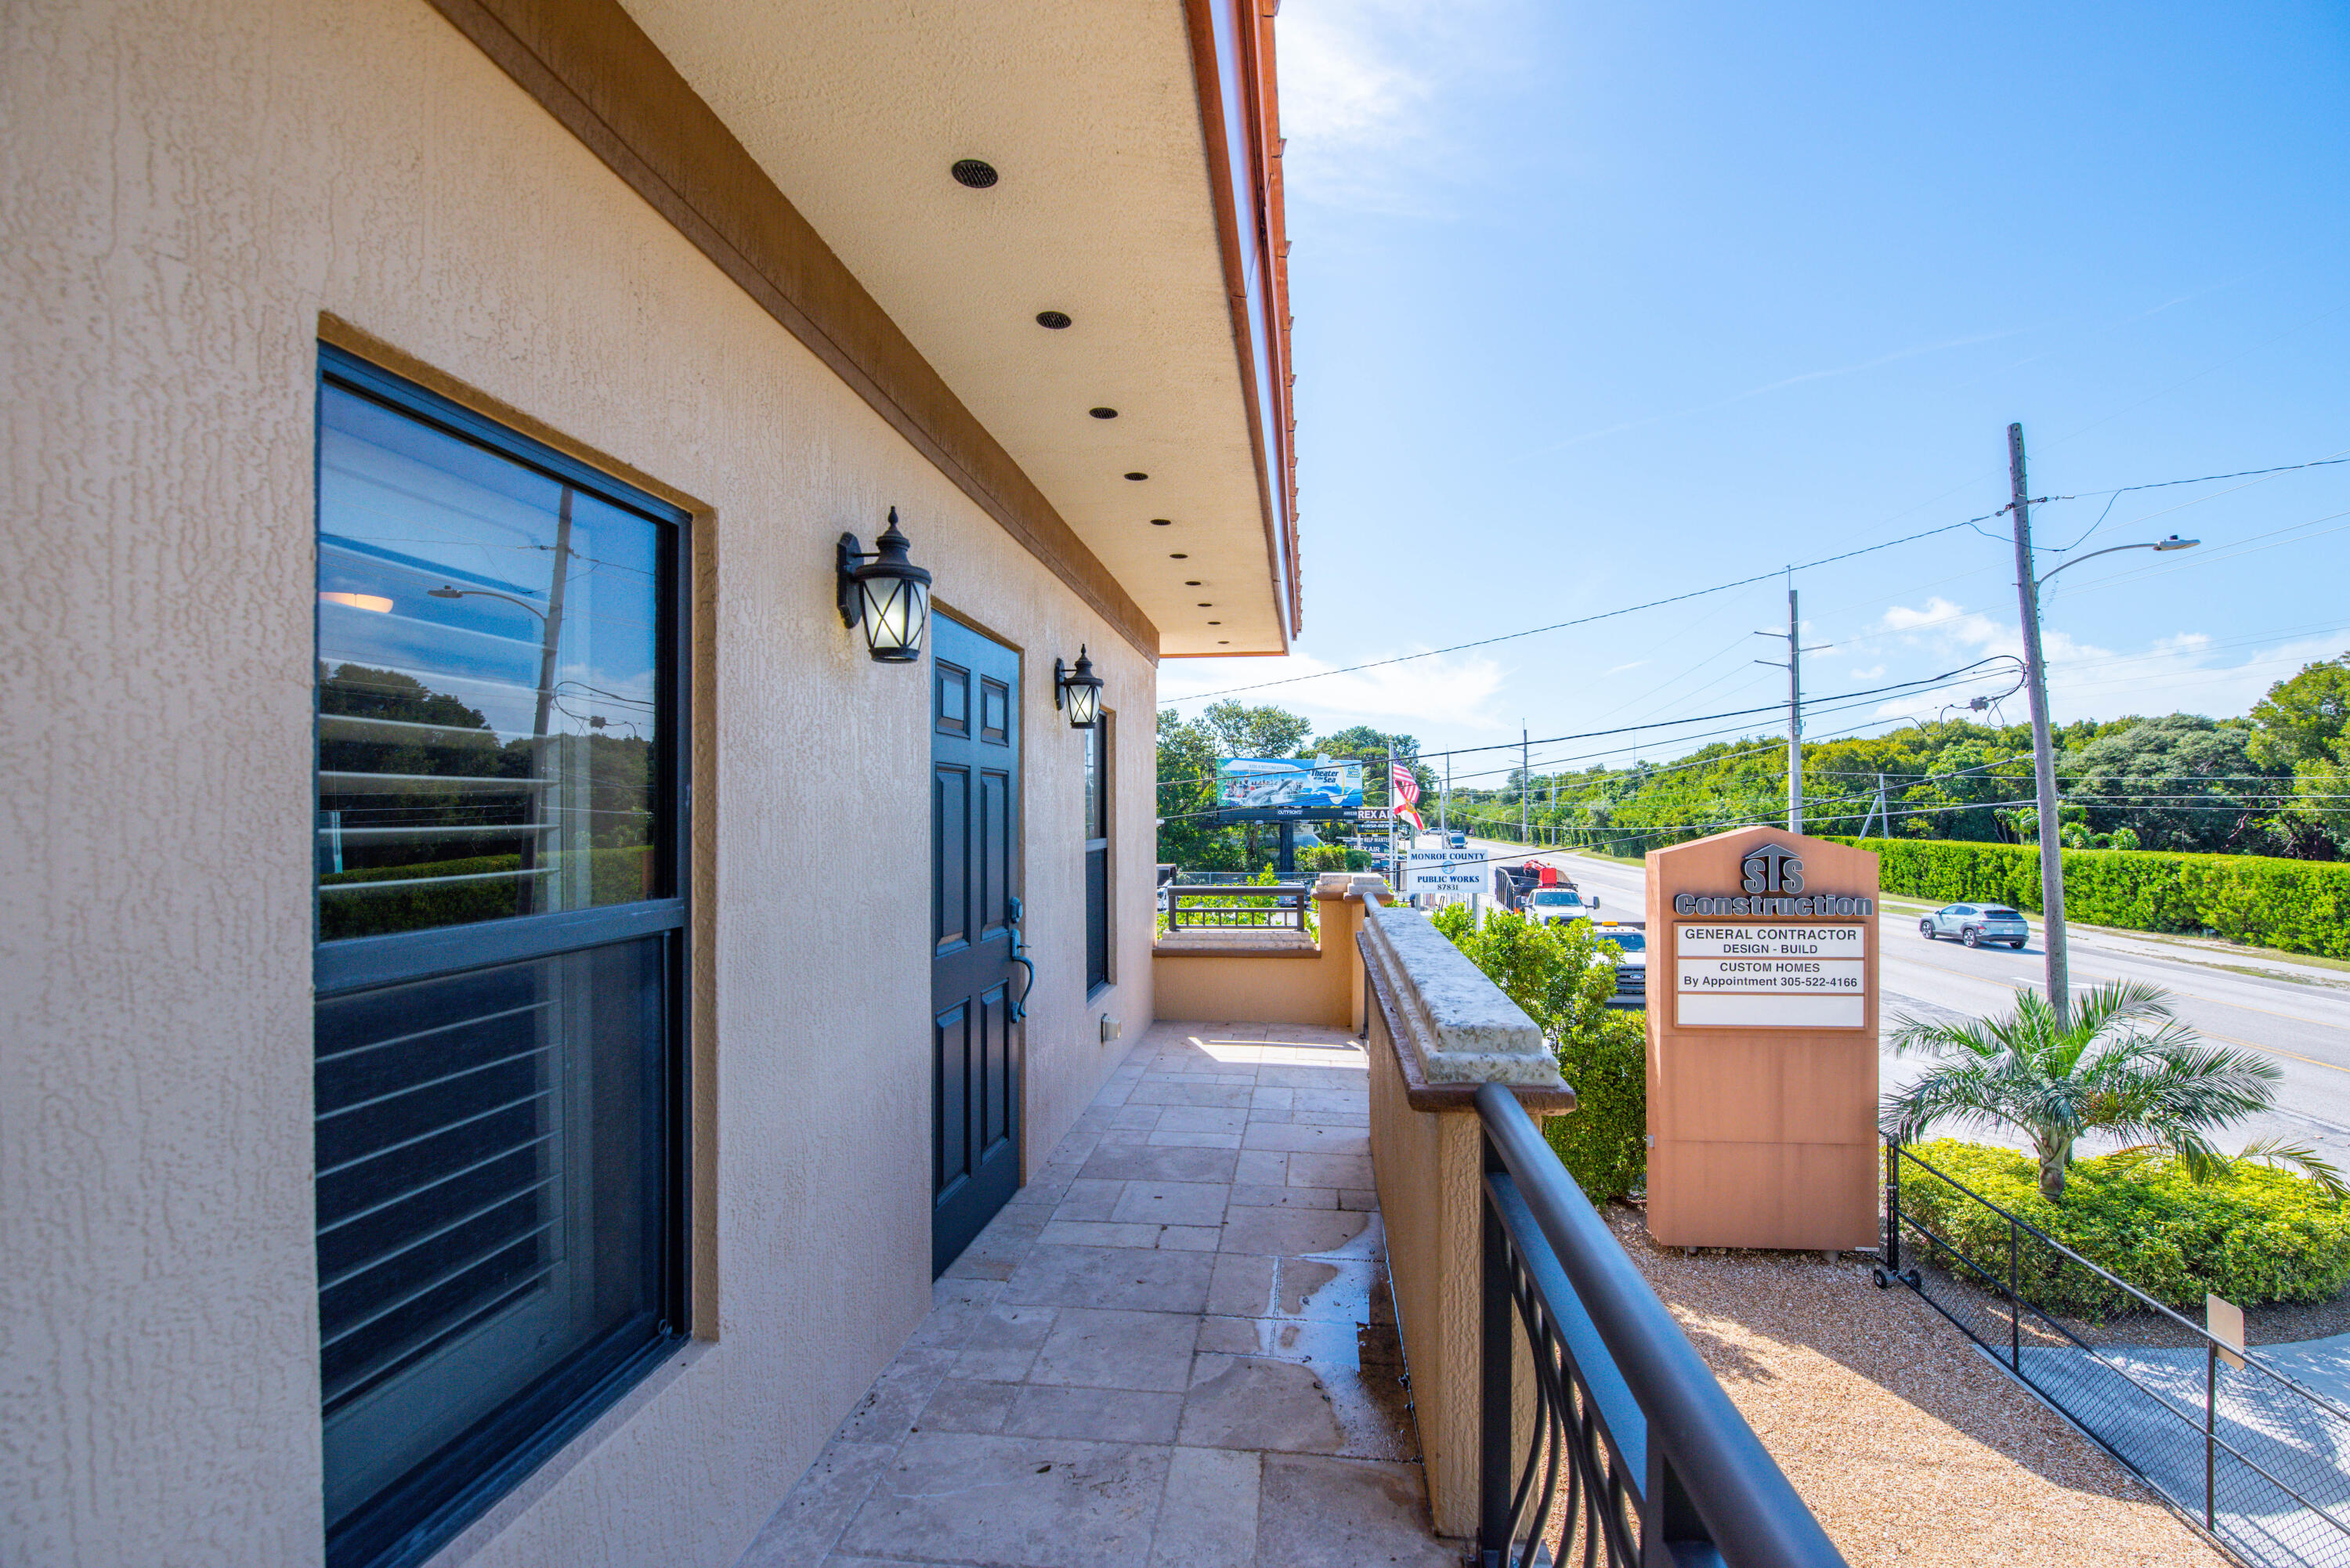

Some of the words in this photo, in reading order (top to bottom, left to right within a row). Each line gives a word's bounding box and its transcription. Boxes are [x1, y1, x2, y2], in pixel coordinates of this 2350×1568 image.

[1358, 810, 1378, 819] REX
[1741, 844, 1804, 894] STS
[1674, 894, 1873, 916] Construction
[1685, 928, 1753, 940] GENERAL
[1757, 929, 1856, 940] CONTRACTOR
[1723, 944, 1770, 953] DESIGN
[1781, 945, 1818, 954] BUILD
[1719, 963, 1772, 972] CUSTOM
[1776, 963, 1820, 972] HOMES
[1683, 976, 1698, 987] By
[1702, 977, 1777, 987] Appointment
[1781, 977, 1857, 987] 305-522-4166
